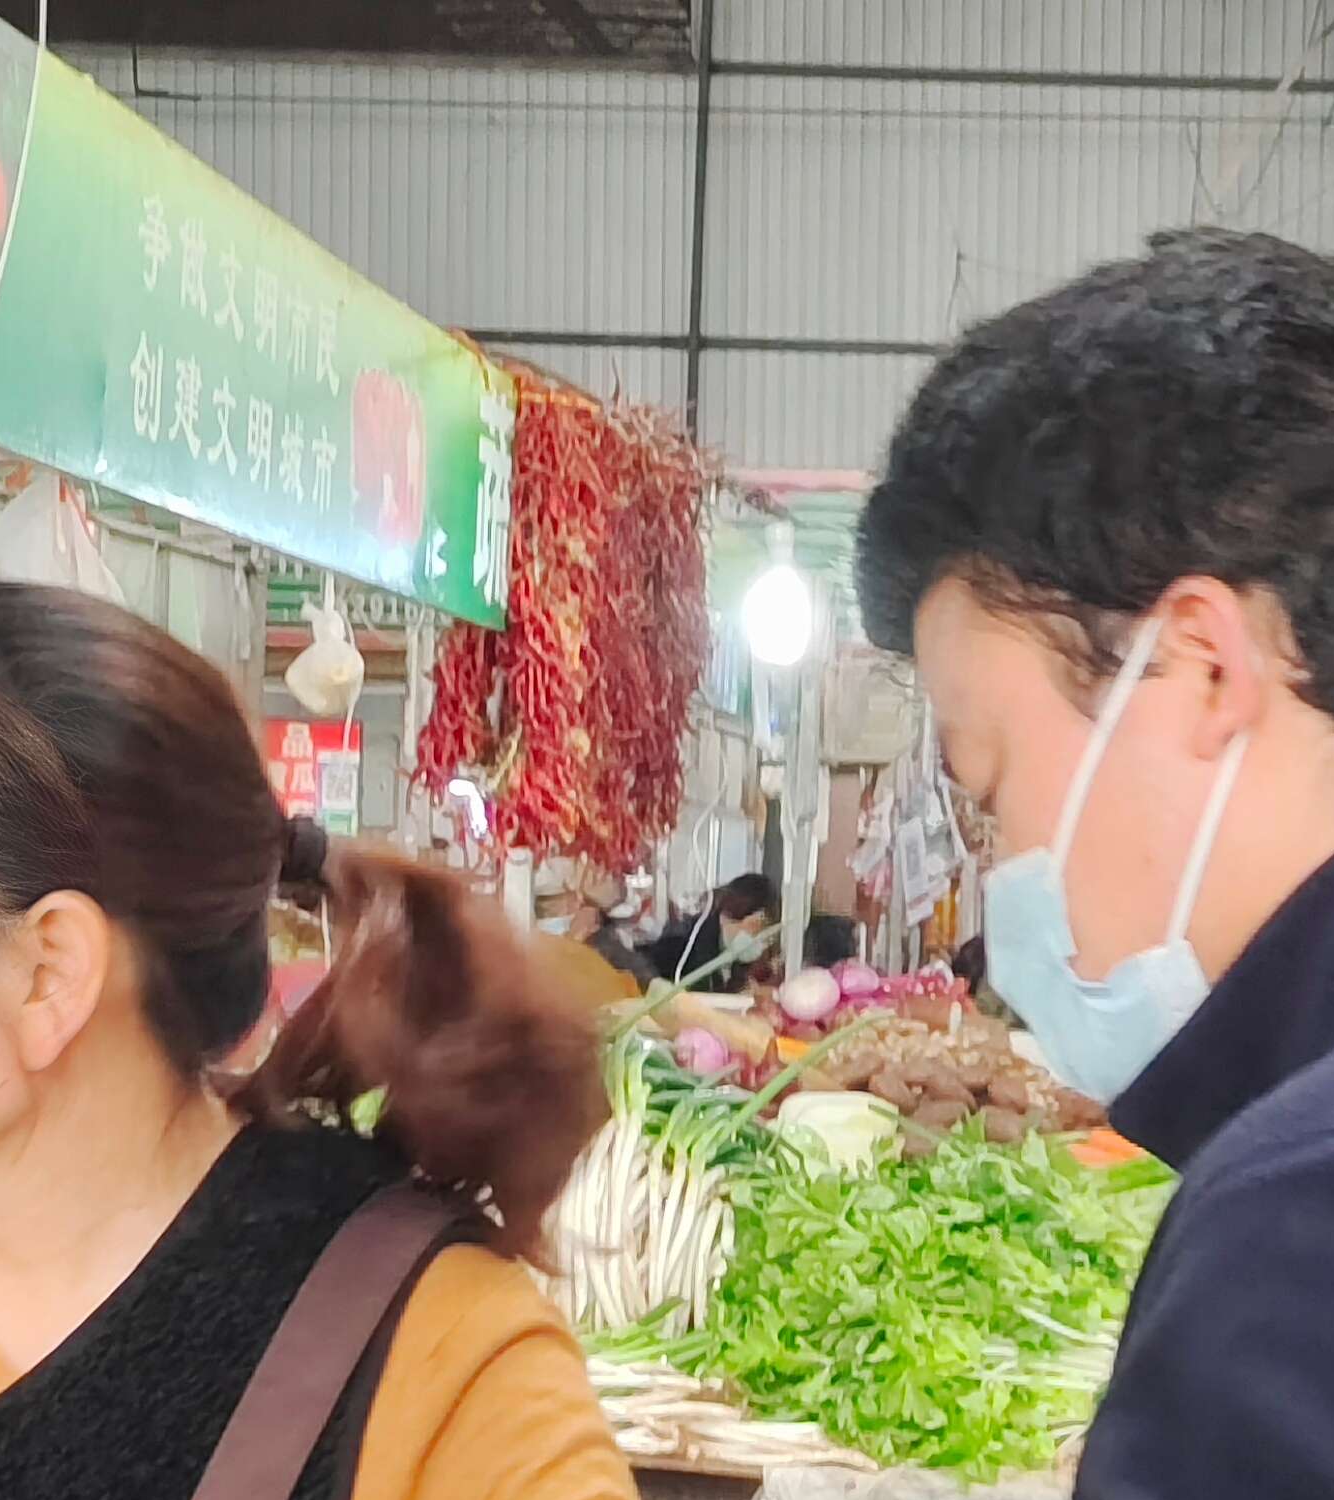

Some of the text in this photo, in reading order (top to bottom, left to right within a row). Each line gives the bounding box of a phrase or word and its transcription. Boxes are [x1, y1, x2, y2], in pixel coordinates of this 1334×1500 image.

[138, 194, 341, 397] 争做文明市民
[130, 330, 338, 513] 创建文明城市
